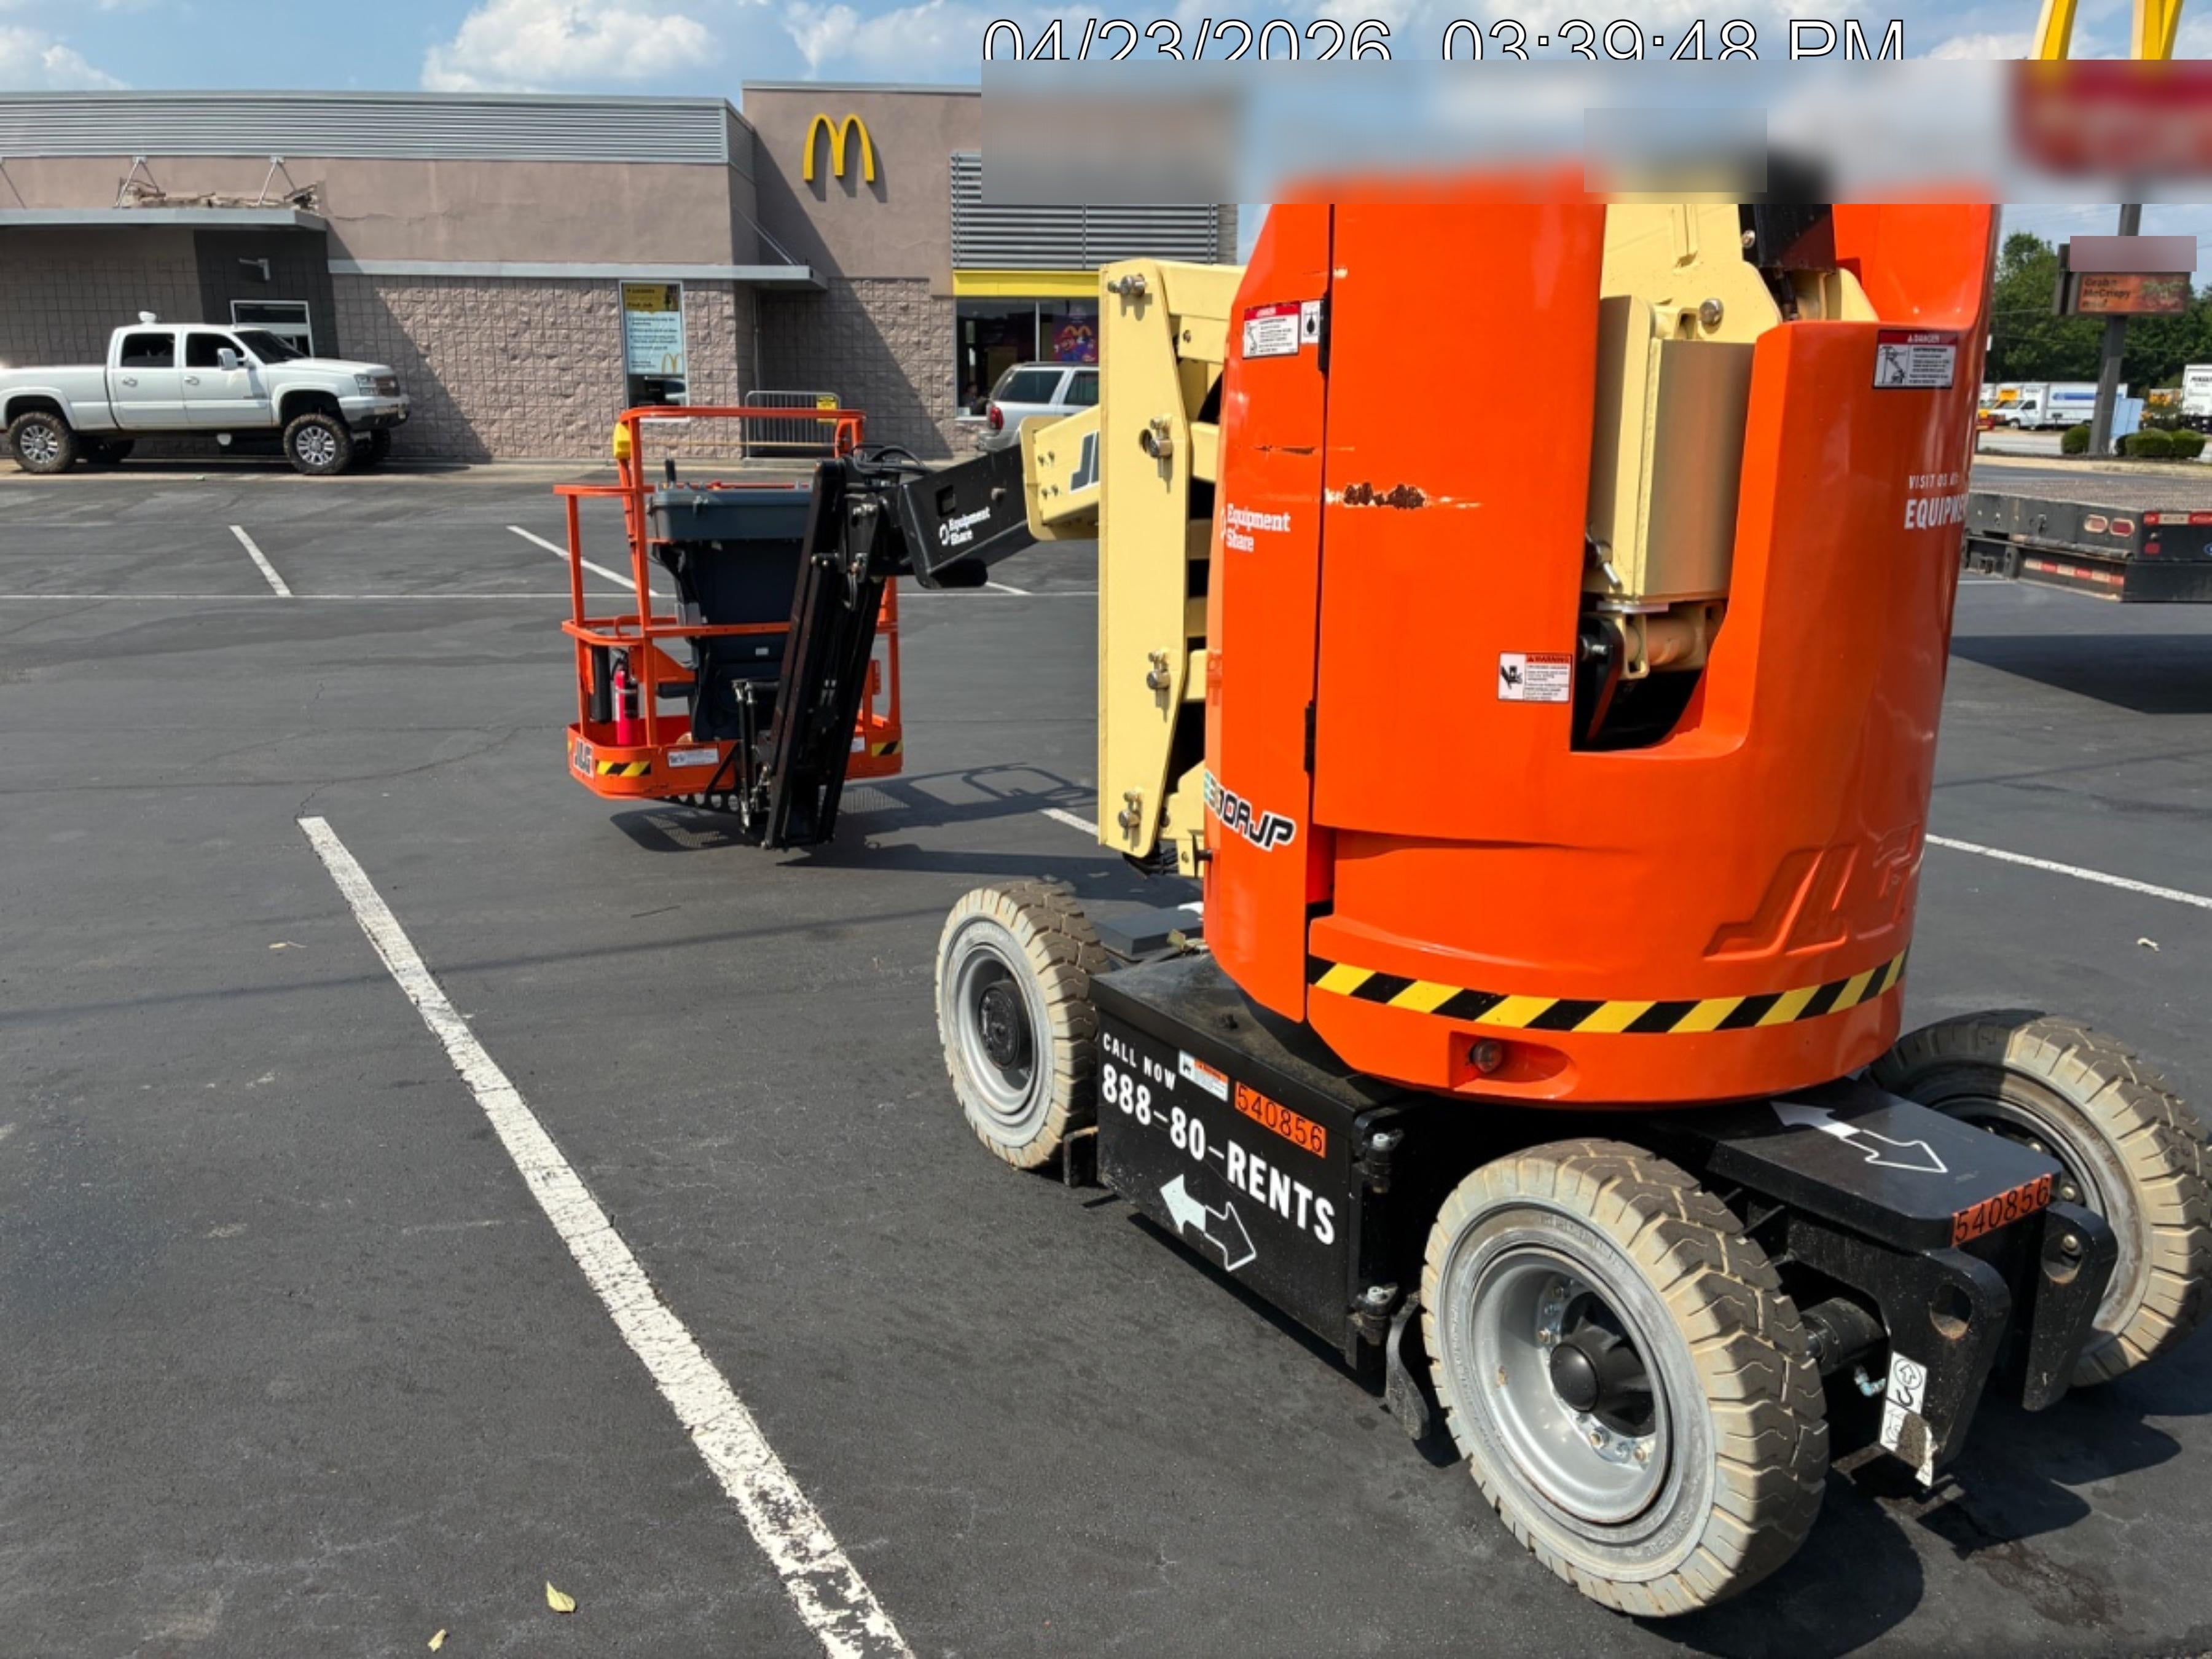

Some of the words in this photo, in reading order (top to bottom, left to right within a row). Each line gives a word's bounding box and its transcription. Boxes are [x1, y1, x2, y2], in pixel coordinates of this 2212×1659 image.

[1909, 474, 1935, 490] VISIT
[948, 506, 990, 532] Equipment
[1227, 503, 1291, 532] Equipment
[950, 529, 973, 546] Share
[1226, 528, 1254, 553] Share
[1104, 1032, 1137, 1068] CALL
[1143, 1055, 1176, 1091] NOW
[1237, 1084, 1323, 1153] 540856
[1102, 1063, 1335, 1245] 888-80-RENTS
[1955, 1177, 2049, 1241] 540856
